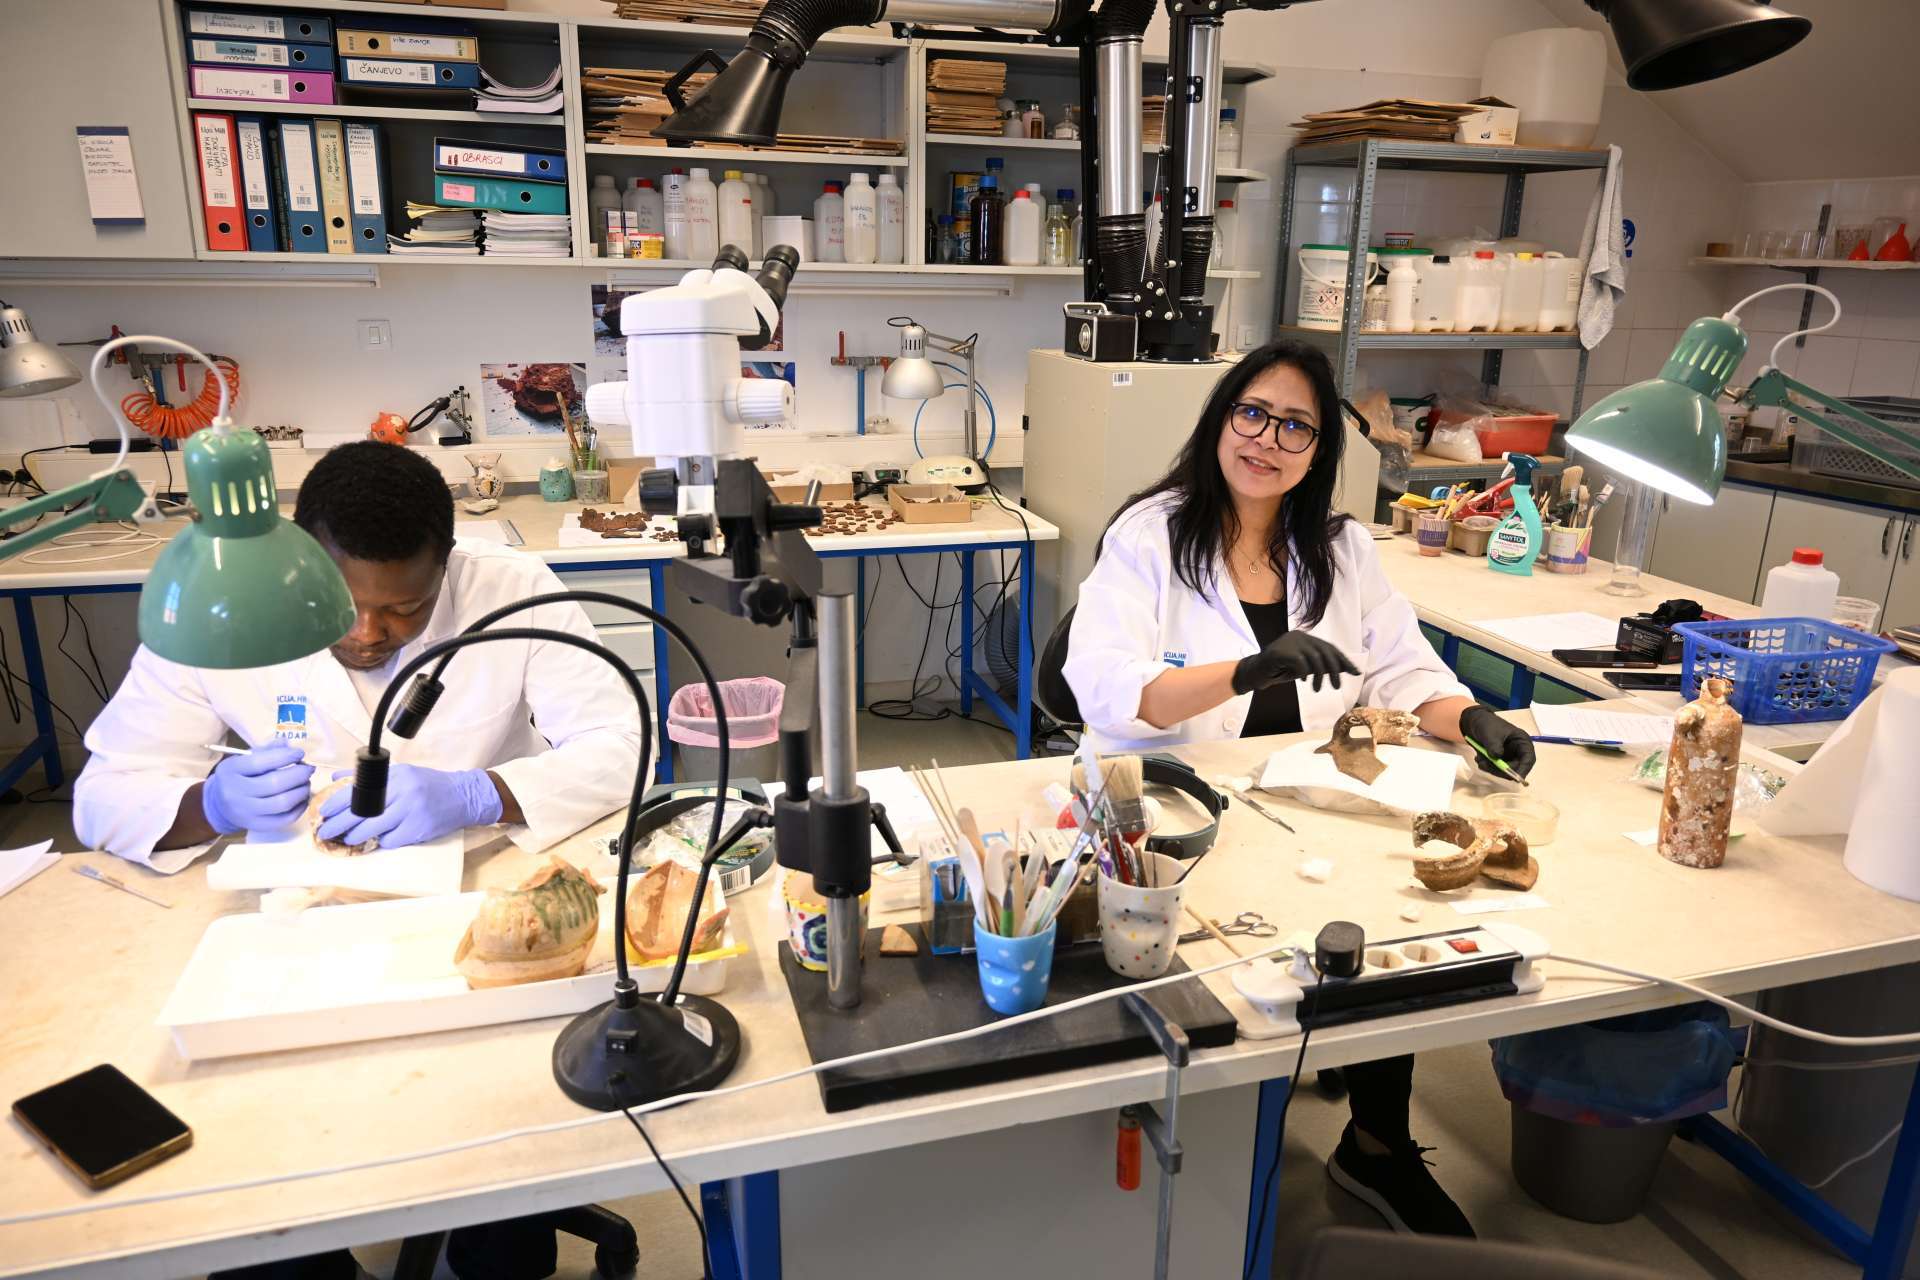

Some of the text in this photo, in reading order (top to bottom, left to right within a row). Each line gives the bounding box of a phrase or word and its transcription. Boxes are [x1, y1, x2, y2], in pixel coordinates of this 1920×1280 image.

[359, 62, 402, 75] ČANJEVO
[462, 152, 503, 166] OBRASCI
[1500, 533, 1525, 544] SANYTOL
[275, 731, 308, 740] ZADAR
